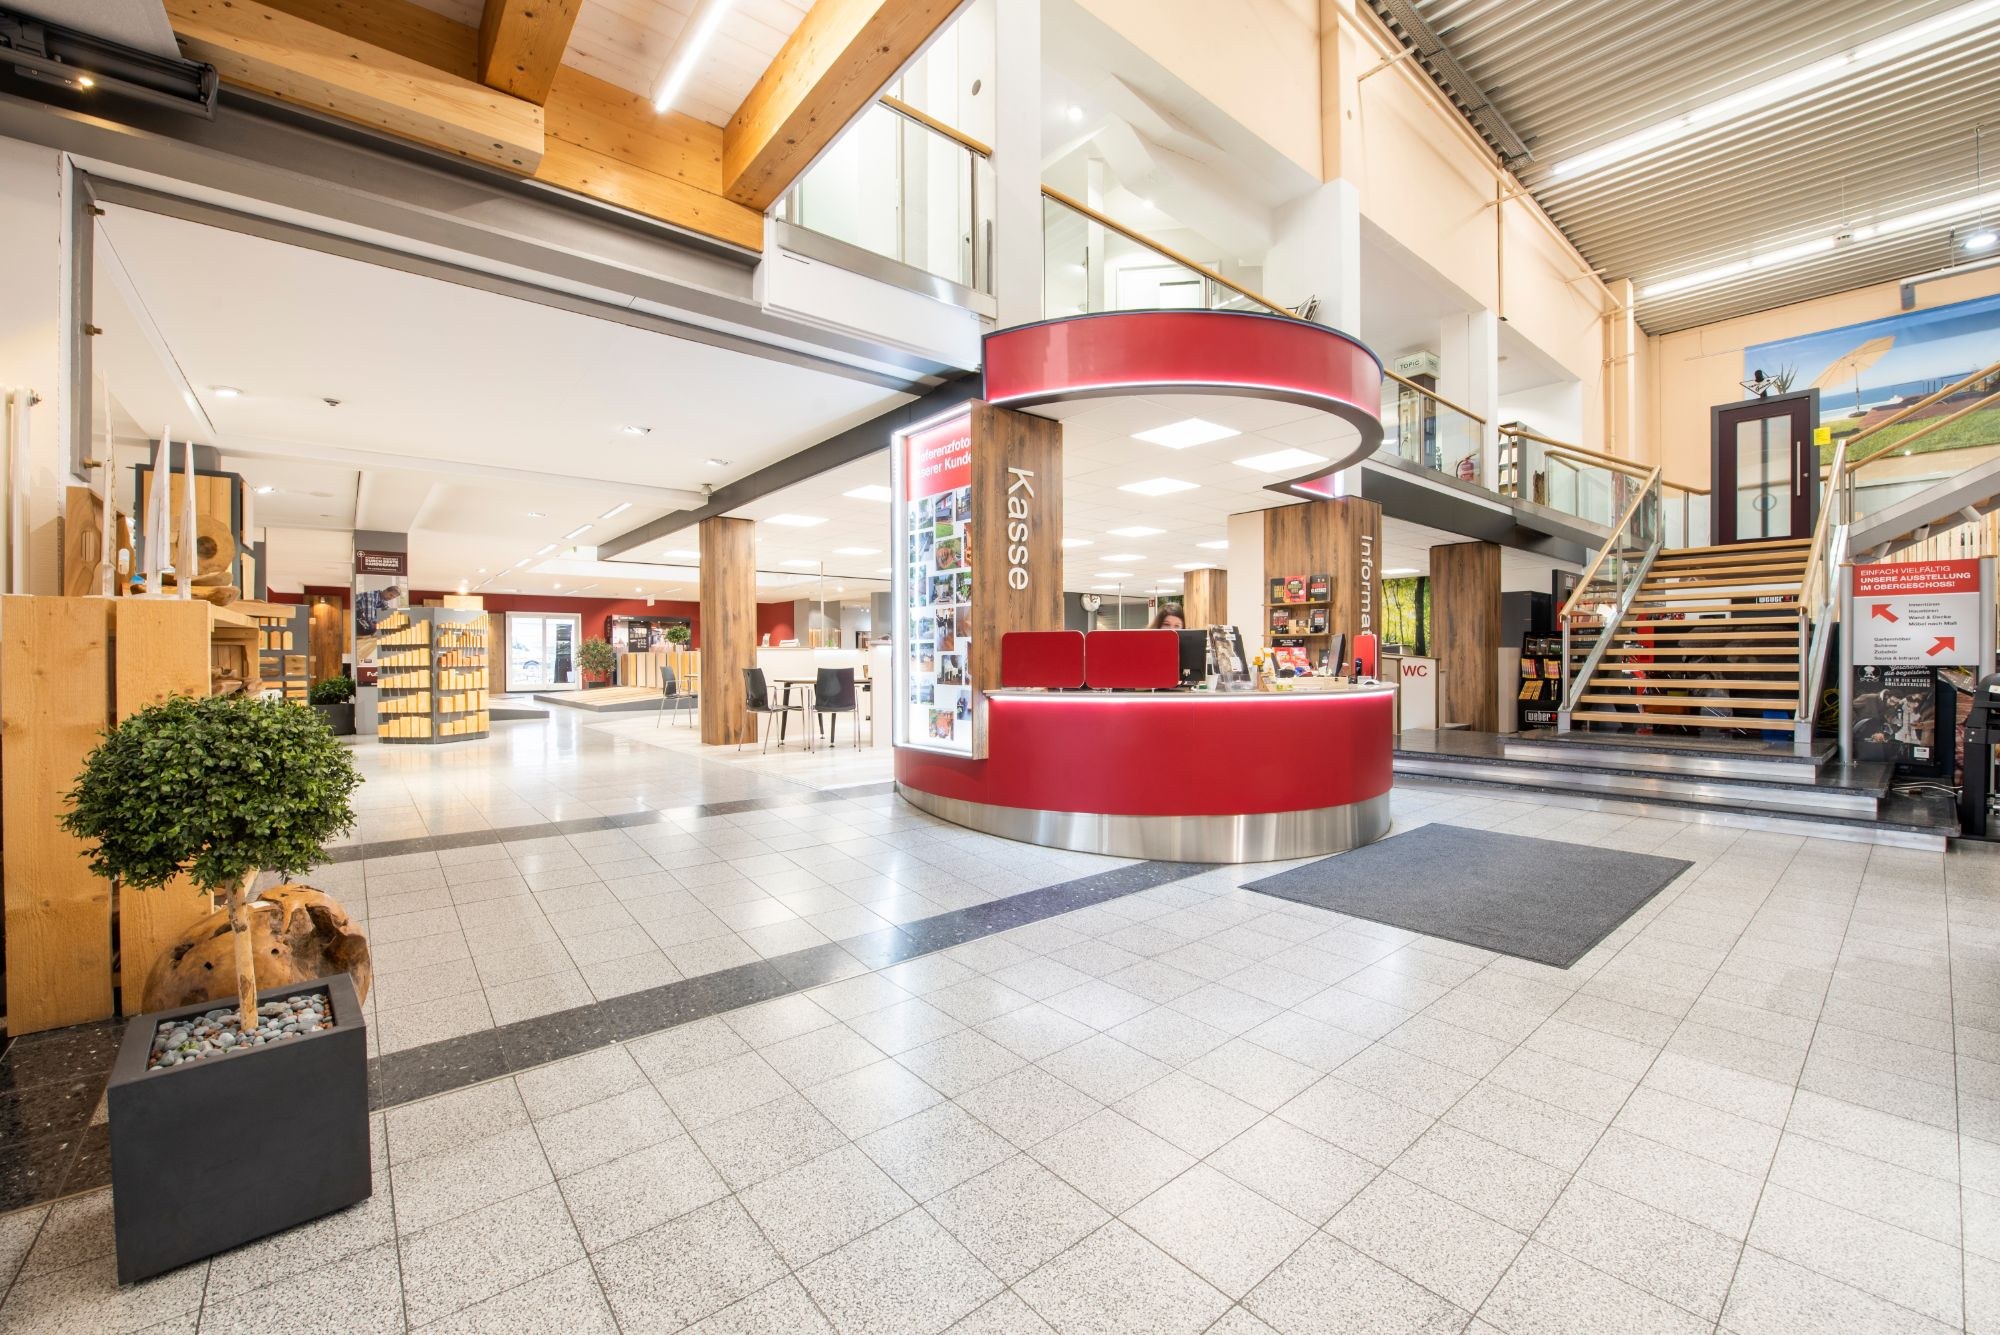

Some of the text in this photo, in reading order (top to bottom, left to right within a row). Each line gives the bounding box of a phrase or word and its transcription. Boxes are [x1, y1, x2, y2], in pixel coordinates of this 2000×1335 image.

[1400, 360, 1420, 370] TOPIC
[917, 437, 971, 461] eferenzfoto
[1008, 467, 1034, 590] Kasse
[1860, 565, 1951, 576] EINFACH VIELFÄLTIG
[1860, 572, 1971, 583] UNSERE AUSSTELLUNG
[1873, 581, 1955, 590] OBERGESCHOSS!
[1402, 665, 1428, 677] WC
